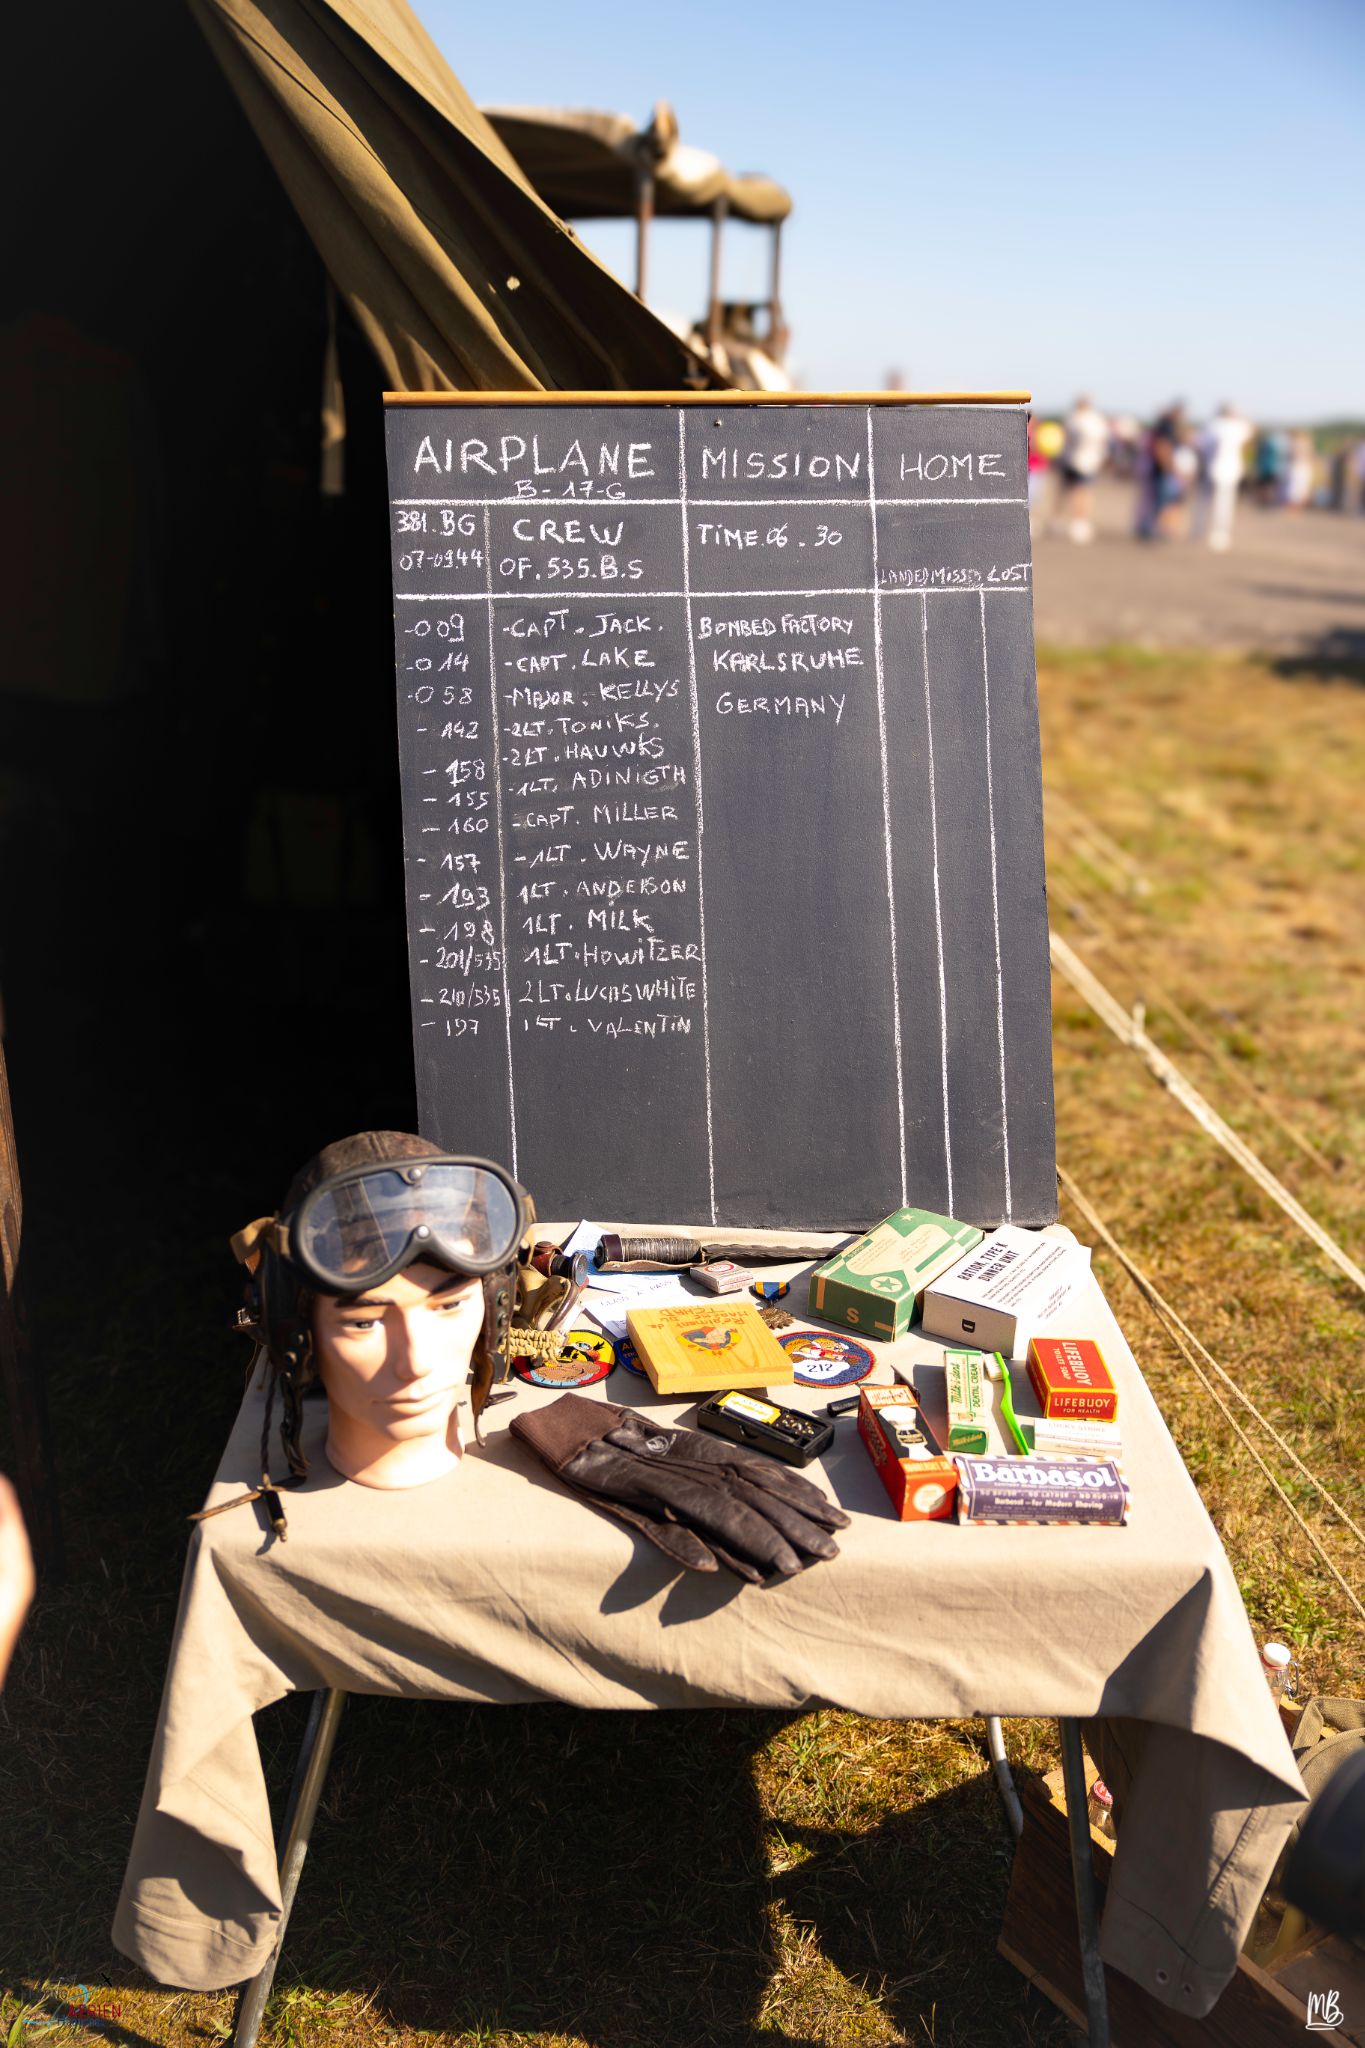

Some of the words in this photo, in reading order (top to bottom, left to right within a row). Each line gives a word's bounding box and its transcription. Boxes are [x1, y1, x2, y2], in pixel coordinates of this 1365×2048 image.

[414, 435, 654, 478] AIRPLANE
[702, 447, 860, 481] MISSION
[900, 453, 1006, 481] HOME
[513, 519, 624, 546] CREW
[881, 567, 929, 586] LANDED
[987, 562, 1033, 582] LOST
[781, 613, 853, 636] FACTORY
[581, 647, 655, 667] LAKE
[713, 647, 864, 673] KARLSRUHE
[716, 693, 846, 725] GERMANY
[448, 817, 489, 834] 160
[440, 852, 480, 874] 157
[593, 839, 690, 867] WAYNE
[576, 877, 687, 897] ANDERSON
[980, 1246, 1003, 1262] TYPE
[978, 1263, 1007, 1282] DINNER
[1003, 1250, 1020, 1264] UNIT
[846, 1307, 860, 1324] S
[962, 1319, 975, 1333] D
[807, 1363, 833, 1373] 212
[1062, 1342, 1092, 1386] LIFEBUOY
[1054, 1397, 1111, 1408] LIFEBUOY
[971, 1462, 1117, 1487] Barbasol
